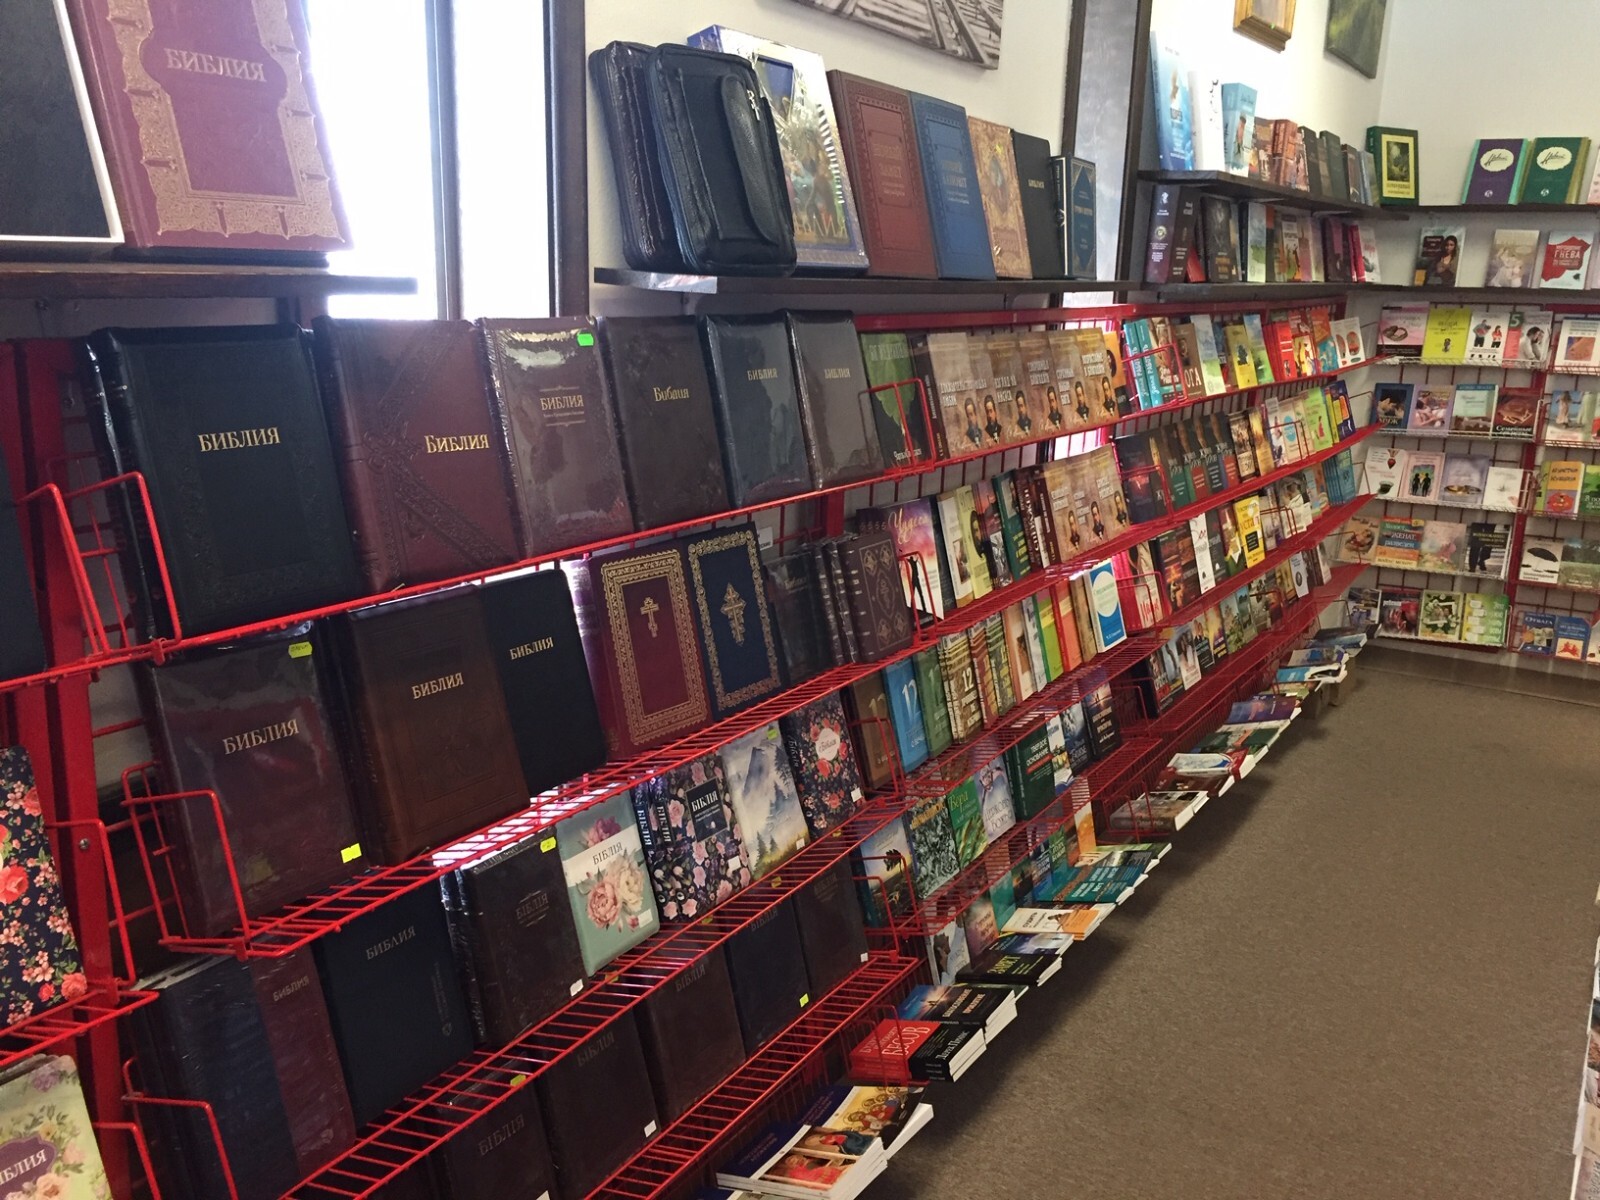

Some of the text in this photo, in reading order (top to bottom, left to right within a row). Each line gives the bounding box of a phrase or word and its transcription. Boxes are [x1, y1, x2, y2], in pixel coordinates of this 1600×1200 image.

[163, 47, 267, 83] БИБЛИЯ
[747, 367, 778, 382] БИБЛИЯ
[824, 367, 851, 380] БИБЛИЯ
[540, 394, 585, 410] БИБЛИЯ
[653, 386, 690, 402] Библия
[198, 426, 281, 453] БИБЛИЯ
[424, 433, 490, 454] БИБЛИЯ
[510, 636, 554, 660] БИБЛИЯ
[412, 672, 464, 700] БИБЛИЯ
[962, 666, 974, 692] 12
[222, 718, 300, 755] БИБЛИЯ
[690, 790, 719, 812] БІБЛІЯ
[636, 809, 653, 846] БІБЛІЯ
[656, 805, 672, 842] БІБЛІЯ
[592, 840, 624, 866] БІБЛІЯ
[515, 892, 549, 920] БІБЛІЯ
[365, 925, 417, 961] БИБЛИЯ
[273, 975, 310, 1002] БИБЛИЯ
[676, 963, 706, 993] БІБЛІЯ
[478, 1113, 526, 1156] БІБЛІЯ
